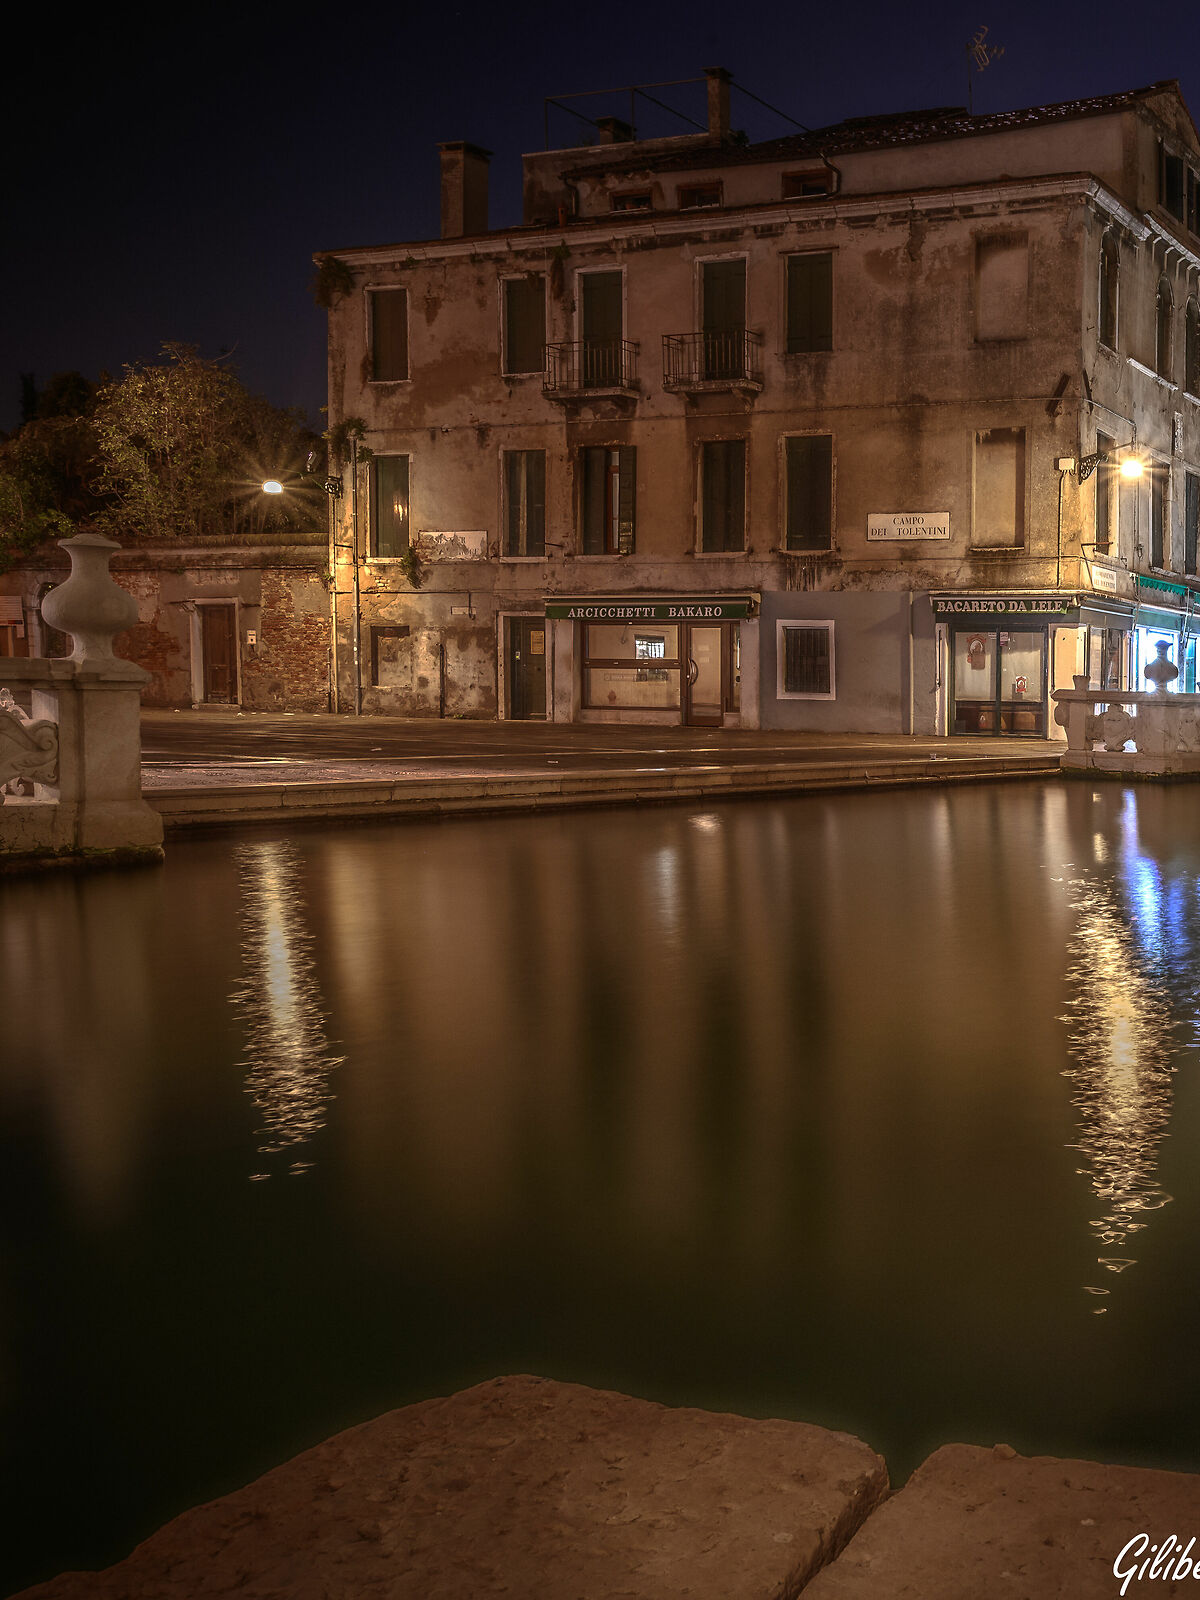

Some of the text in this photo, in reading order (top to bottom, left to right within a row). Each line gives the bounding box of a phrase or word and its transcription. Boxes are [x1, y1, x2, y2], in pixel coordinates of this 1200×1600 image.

[893, 516, 925, 525] CAMPO
[897, 526, 946, 536] TOLENTINI
[936, 601, 1063, 612] BACARETO DA LELE
[567, 606, 723, 618] ARCICCHETTI BAKARO
